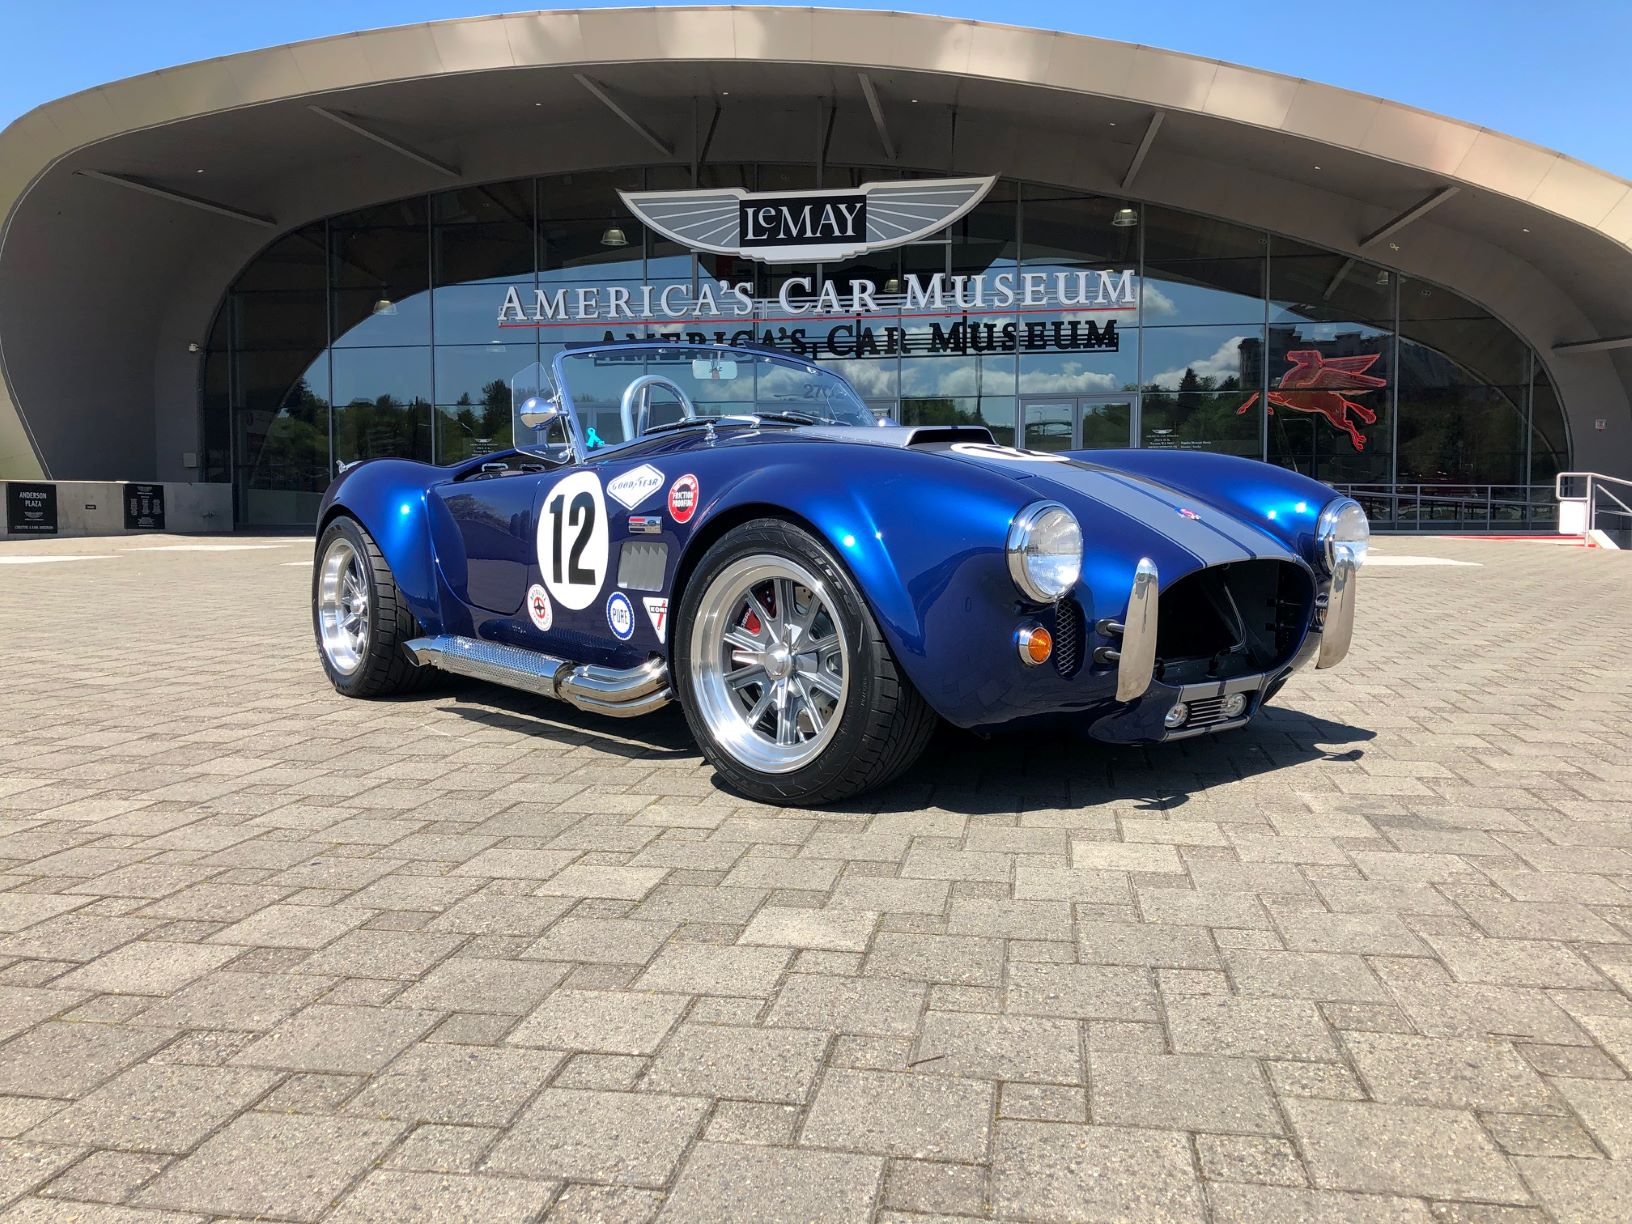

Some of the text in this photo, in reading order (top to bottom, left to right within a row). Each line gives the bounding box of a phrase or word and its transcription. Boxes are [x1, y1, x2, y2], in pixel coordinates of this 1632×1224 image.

[744, 203, 864, 240] LeMAY
[497, 269, 1136, 321] AMERICA'S CAR MUSEUM
[929, 319, 1118, 353] MUSEUM
[19, 491, 47, 499] ANDERSON
[549, 491, 597, 586] 12
[612, 607, 628, 625] PURE
